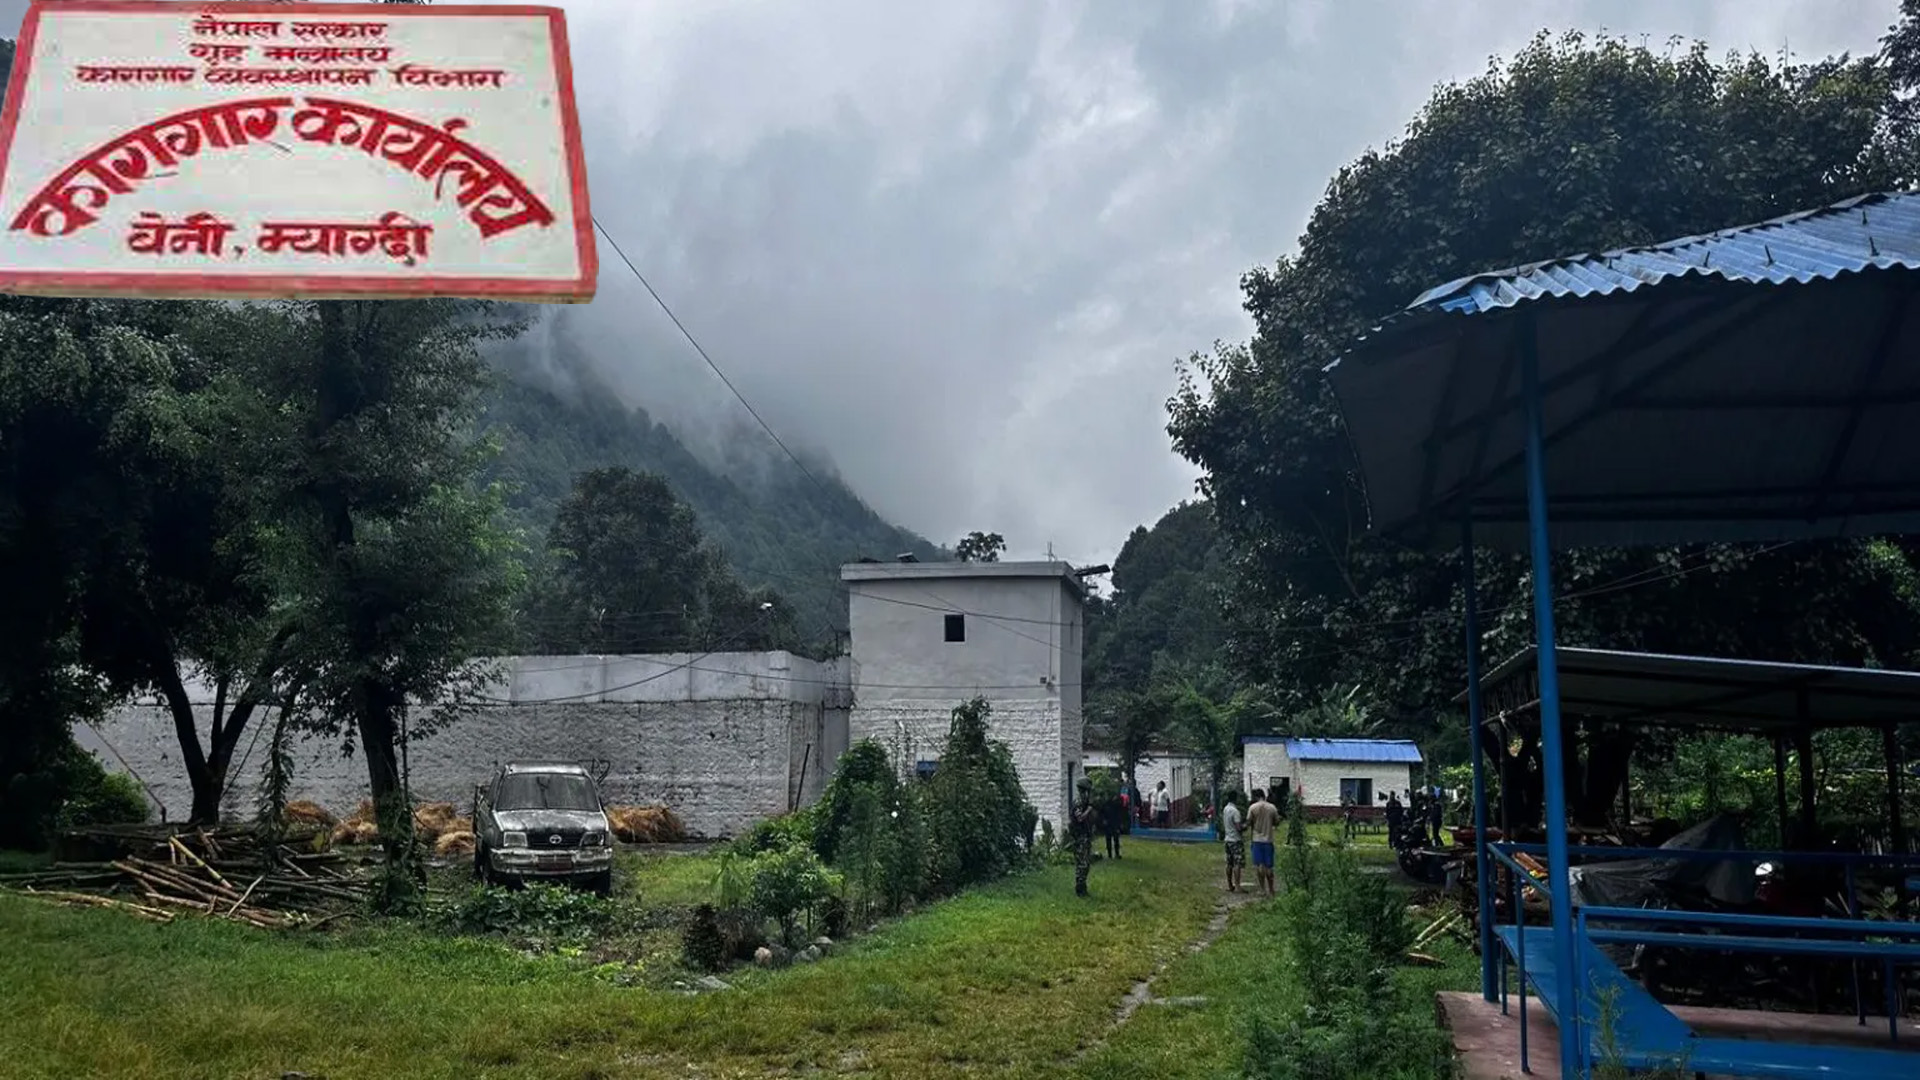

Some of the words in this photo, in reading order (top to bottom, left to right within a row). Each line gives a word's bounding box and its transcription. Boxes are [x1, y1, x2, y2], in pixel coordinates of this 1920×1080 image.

[192, 15, 282, 37] नेपाल
[292, 22, 387, 39] सरकार
[189, 43, 248, 66] गृह
[77, 66, 195, 83] कारागार
[204, 67, 377, 86] व्यवस्थापन
[388, 64, 504, 87] विभाग
[9, 97, 293, 236] कारागार
[289, 97, 555, 238] कार्यालय
[257, 211, 434, 266] म्याग्दी
